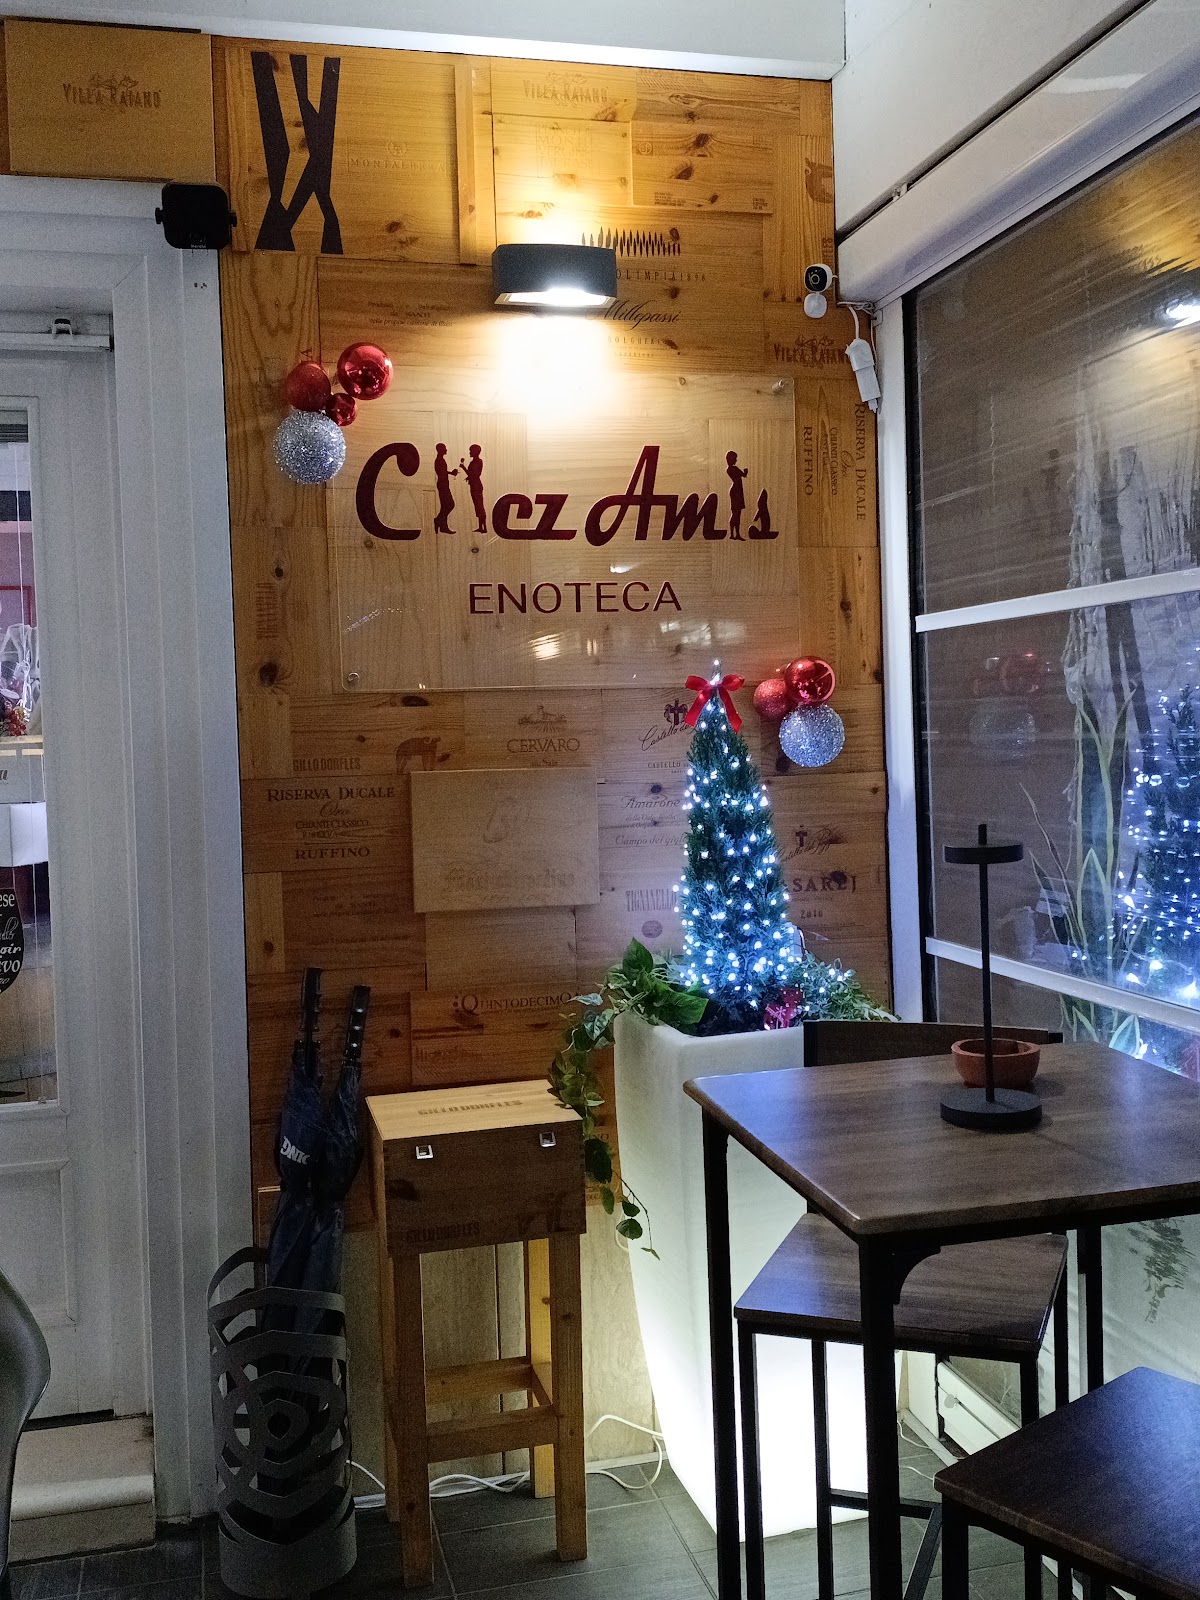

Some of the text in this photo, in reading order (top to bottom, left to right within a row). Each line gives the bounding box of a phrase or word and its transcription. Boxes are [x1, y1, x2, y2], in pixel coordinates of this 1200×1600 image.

[803, 426, 814, 497] RUFFINO
[854, 403, 867, 521] RISERVA DUCALE
[585, 445, 779, 547] Amis
[469, 580, 682, 615] ENOTECA
[506, 738, 581, 754] CERVARO
[267, 786, 396, 802] RISERVA DUCALE
[620, 795, 681, 809] Amarone
[615, 834, 648, 847] Campo
[295, 846, 371, 860] RUFFINO
